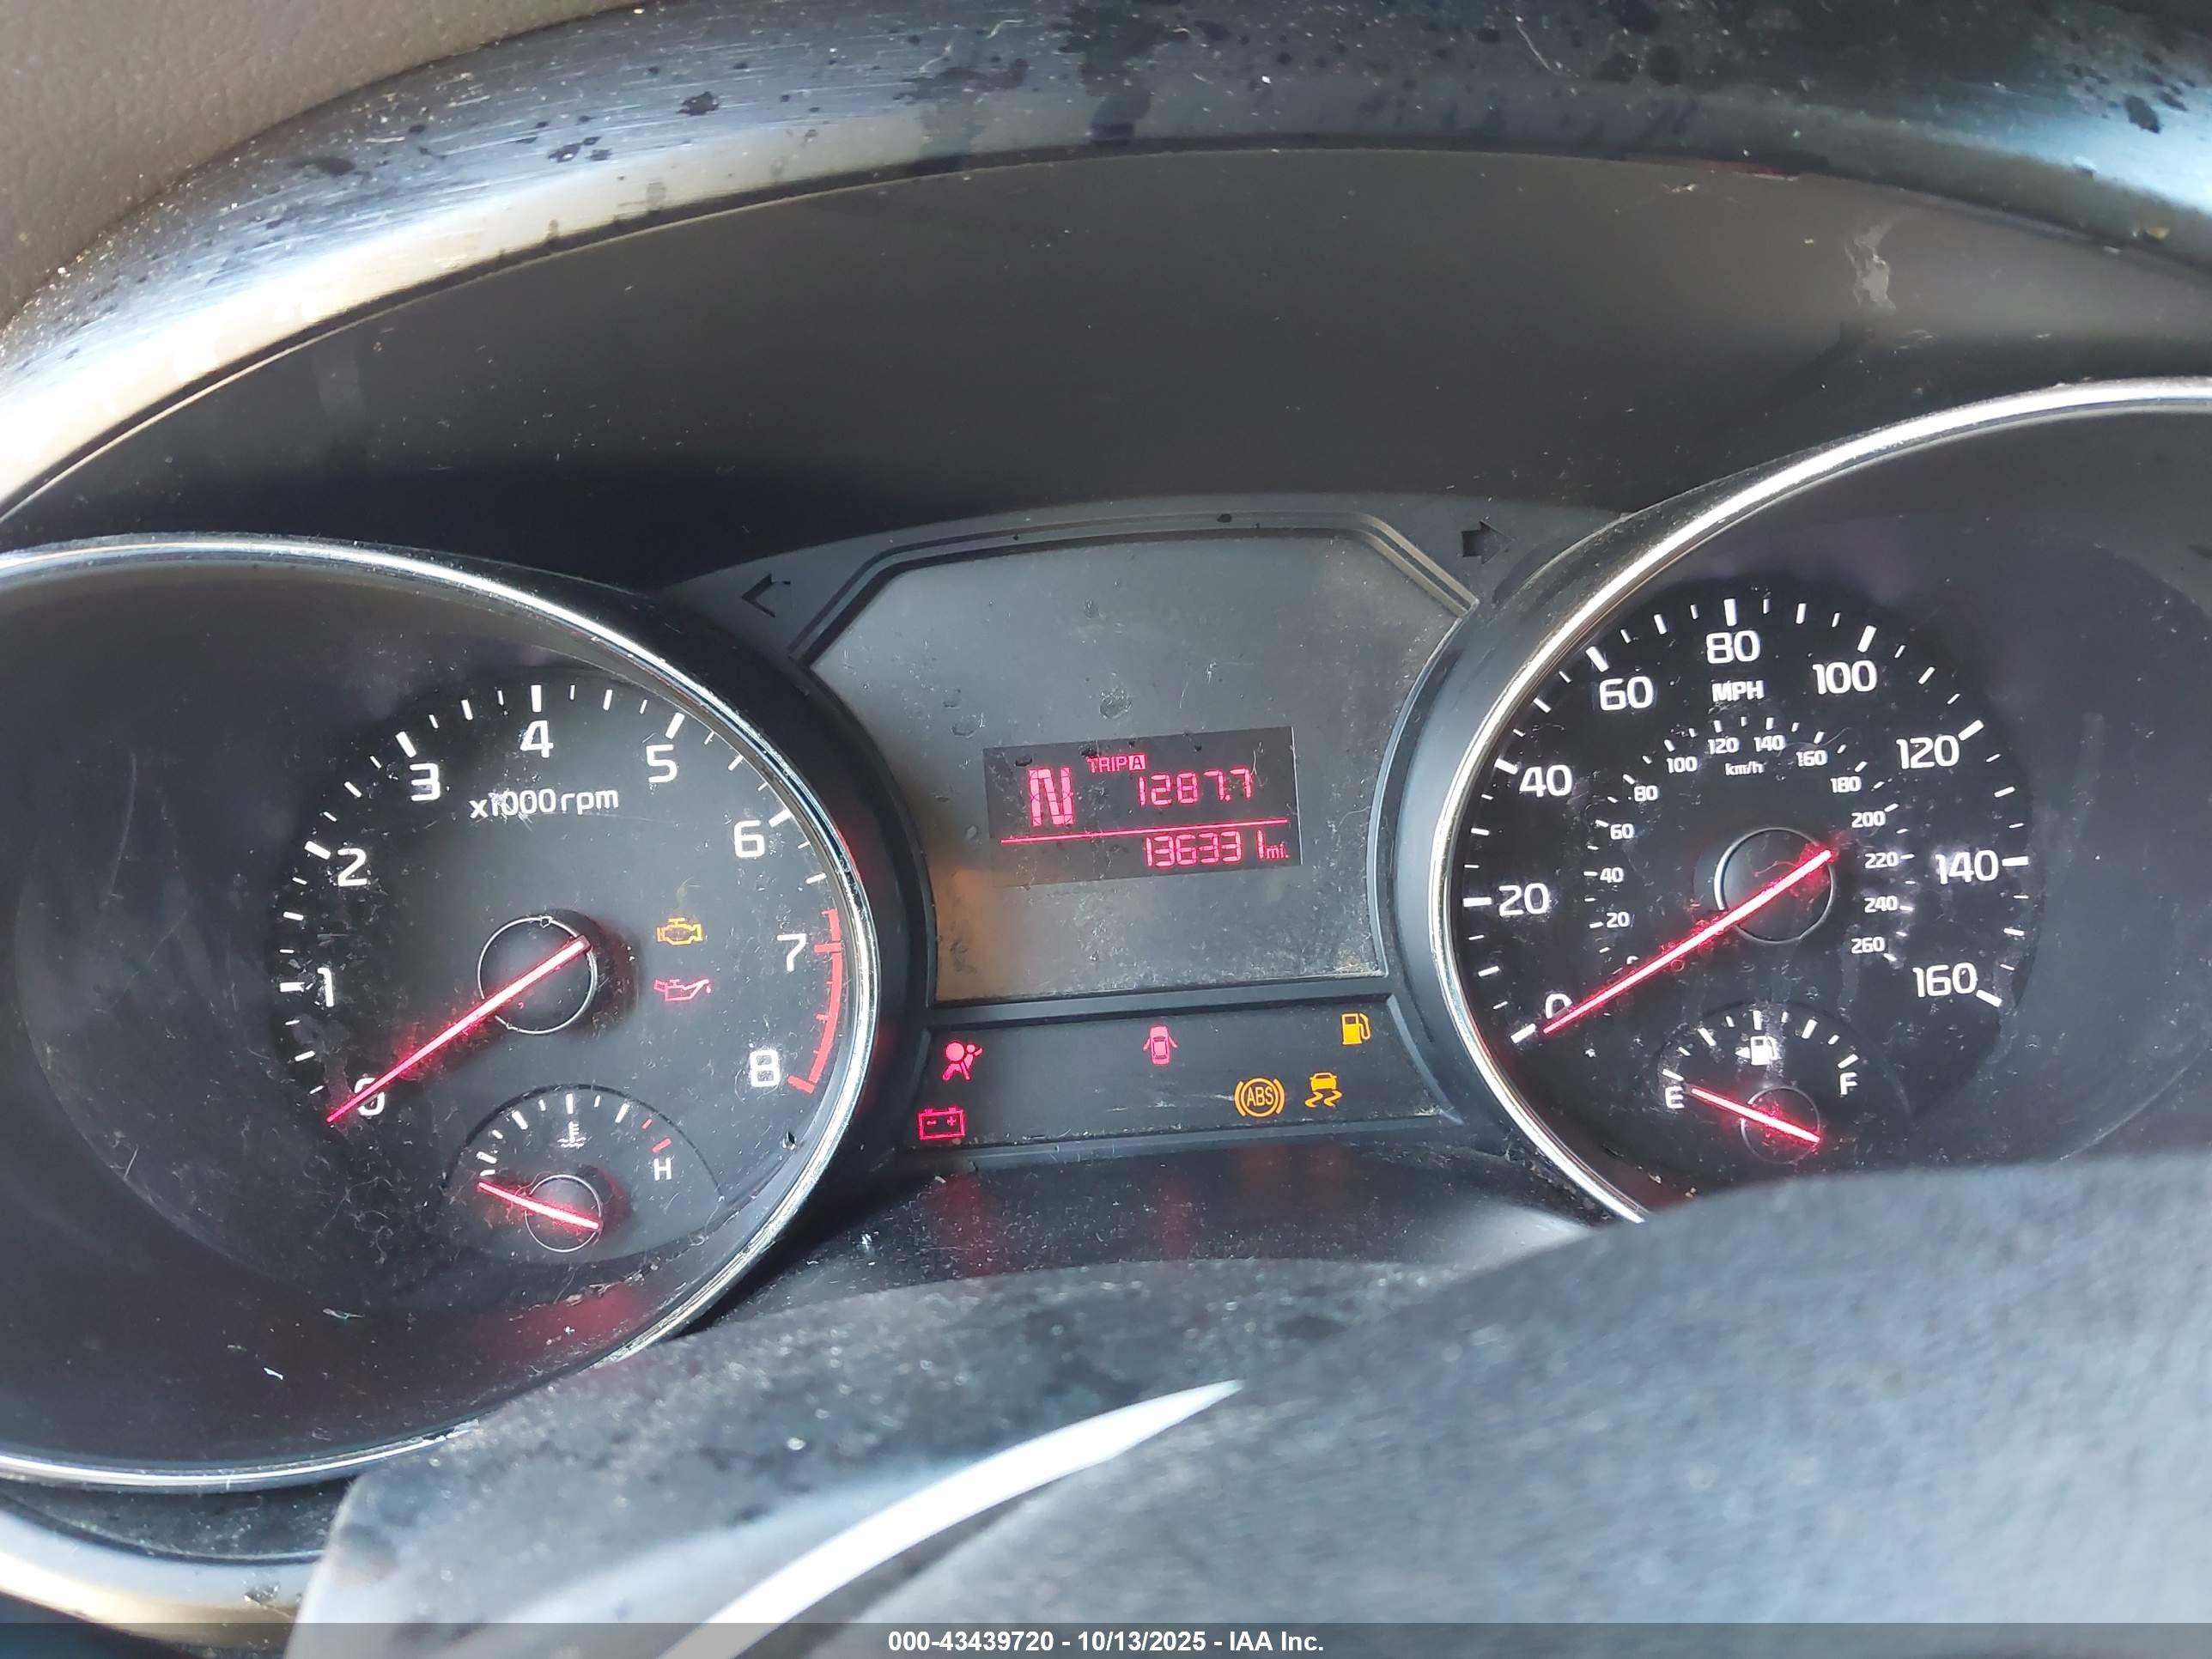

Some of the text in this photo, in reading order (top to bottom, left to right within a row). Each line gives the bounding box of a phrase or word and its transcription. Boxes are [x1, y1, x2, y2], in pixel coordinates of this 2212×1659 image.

[1706, 630, 1760, 664] 80
[1711, 680, 1765, 702] MPH
[1813, 659, 1877, 695] 100
[1600, 677, 1654, 711] 60
[520, 720, 554, 758] 4
[1708, 736, 1740, 755] 120
[1753, 735, 1785, 752] 140
[1896, 734, 1959, 769] 120
[646, 744, 678, 782] 5
[1087, 756, 1127, 773] TRIP
[1666, 757, 1698, 773] 100
[1725, 761, 1765, 776] km/h
[410, 763, 441, 801] 3
[1139, 768, 1252, 805] 1287.7
[1518, 764, 1572, 798] 40
[1633, 785, 1658, 802] 80
[1830, 776, 1862, 793] 180
[469, 788, 619, 817] x1000 rpm
[1029, 767, 1073, 827] N
[1609, 823, 1634, 841] 60
[1851, 811, 1885, 829] 200
[733, 820, 765, 858] 6
[1145, 830, 1264, 866] 136331
[337, 848, 368, 886] 2
[1600, 866, 1624, 884] 40
[1864, 851, 1899, 869] 220
[1936, 849, 1999, 884] 140
[1498, 883, 1549, 916] 20
[1863, 895, 1899, 913] 240
[1606, 912, 1630, 929] 20
[777, 933, 807, 972] 7
[1850, 937, 1886, 954] 260
[317, 967, 335, 1007] 1
[1913, 963, 1978, 998] 160
[749, 1049, 781, 1087] 8
[354, 1077, 386, 1116] 0
[1247, 1086, 1274, 1107] ABS
[1665, 1085, 1685, 1109] E
[1839, 1072, 1858, 1097] F
[653, 1158, 672, 1181] H
